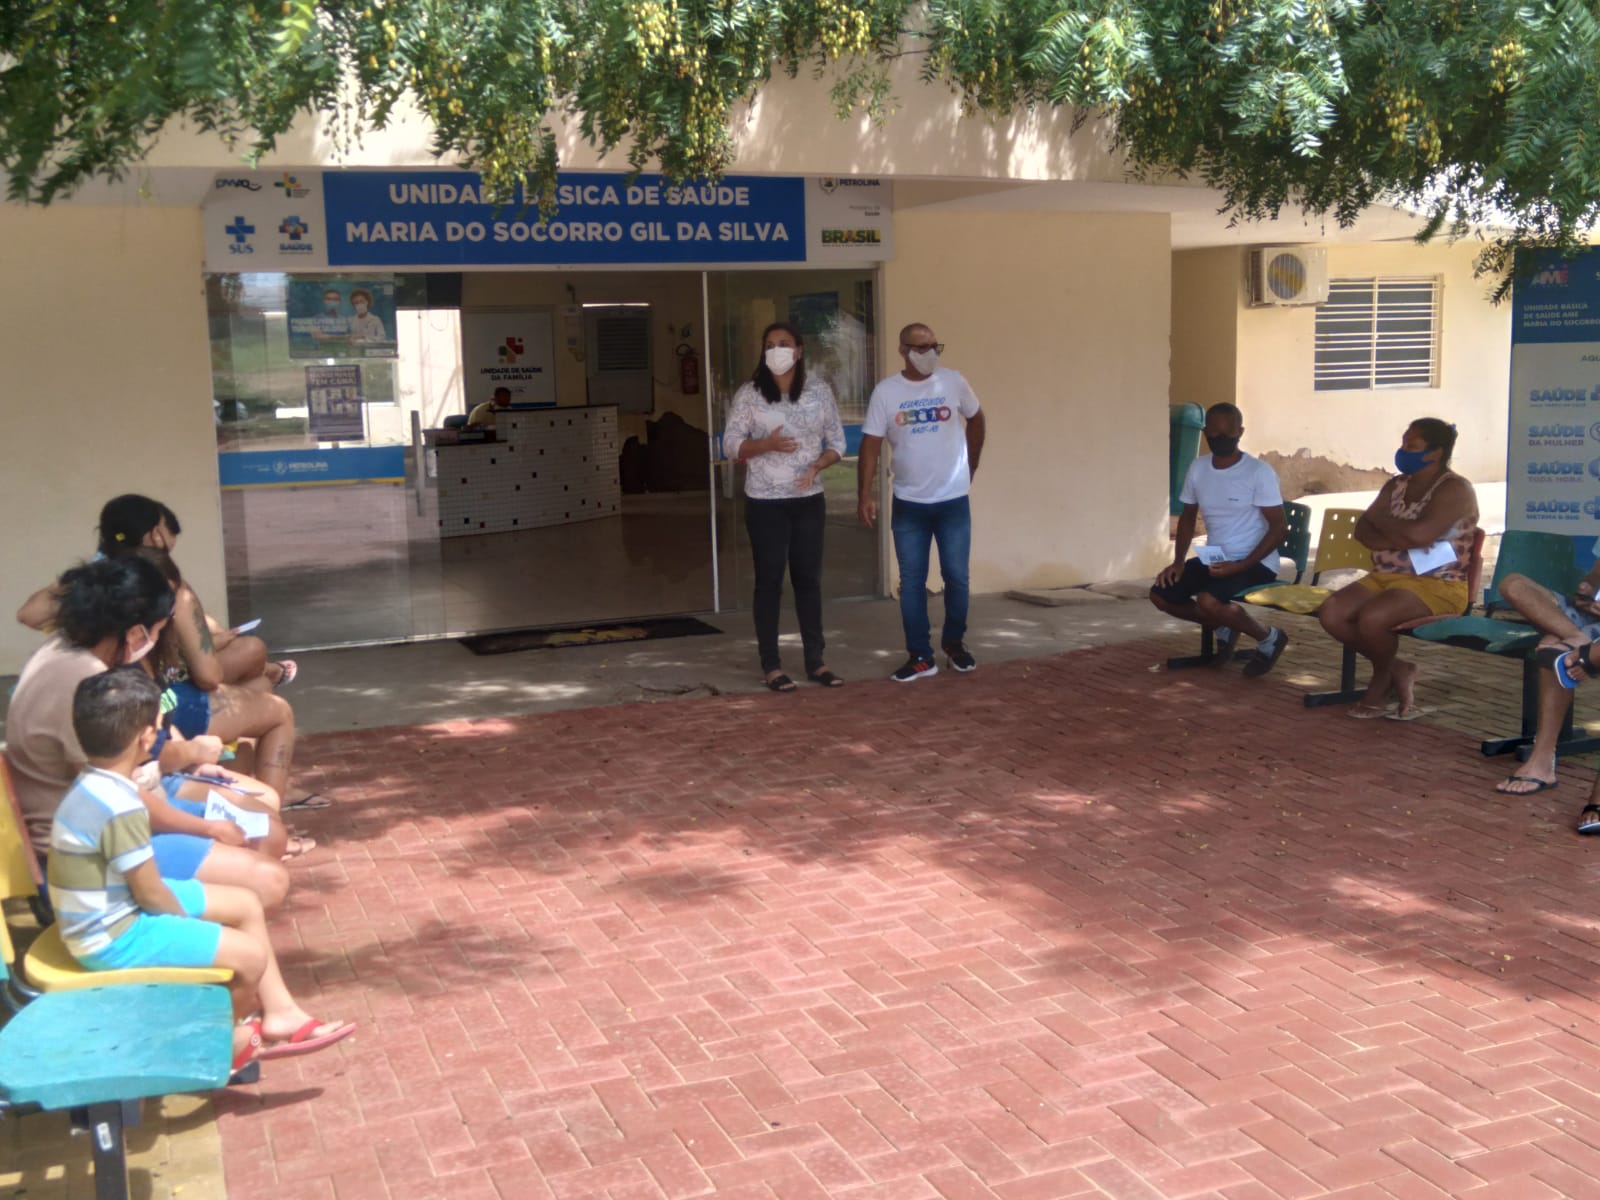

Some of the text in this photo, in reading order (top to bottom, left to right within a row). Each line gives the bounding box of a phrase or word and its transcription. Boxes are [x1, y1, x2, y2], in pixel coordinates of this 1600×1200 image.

[839, 178, 881, 187] PETROLINA
[627, 186, 660, 206] DE
[346, 220, 789, 243] MARIA DO SOCORRO GIL DA SILVA
[821, 229, 881, 244] BRASIL
[228, 244, 254, 255] SUS
[1523, 303, 1559, 312] UNIDADE
[1523, 312, 1534, 320] DE
[1523, 320, 1548, 328] MARIA
[1530, 386, 1586, 401] SAÚDE
[1528, 423, 1585, 438] SAÚDE
[1527, 460, 1584, 475] SAÚDE
[1526, 498, 1580, 513] SAÚDE
